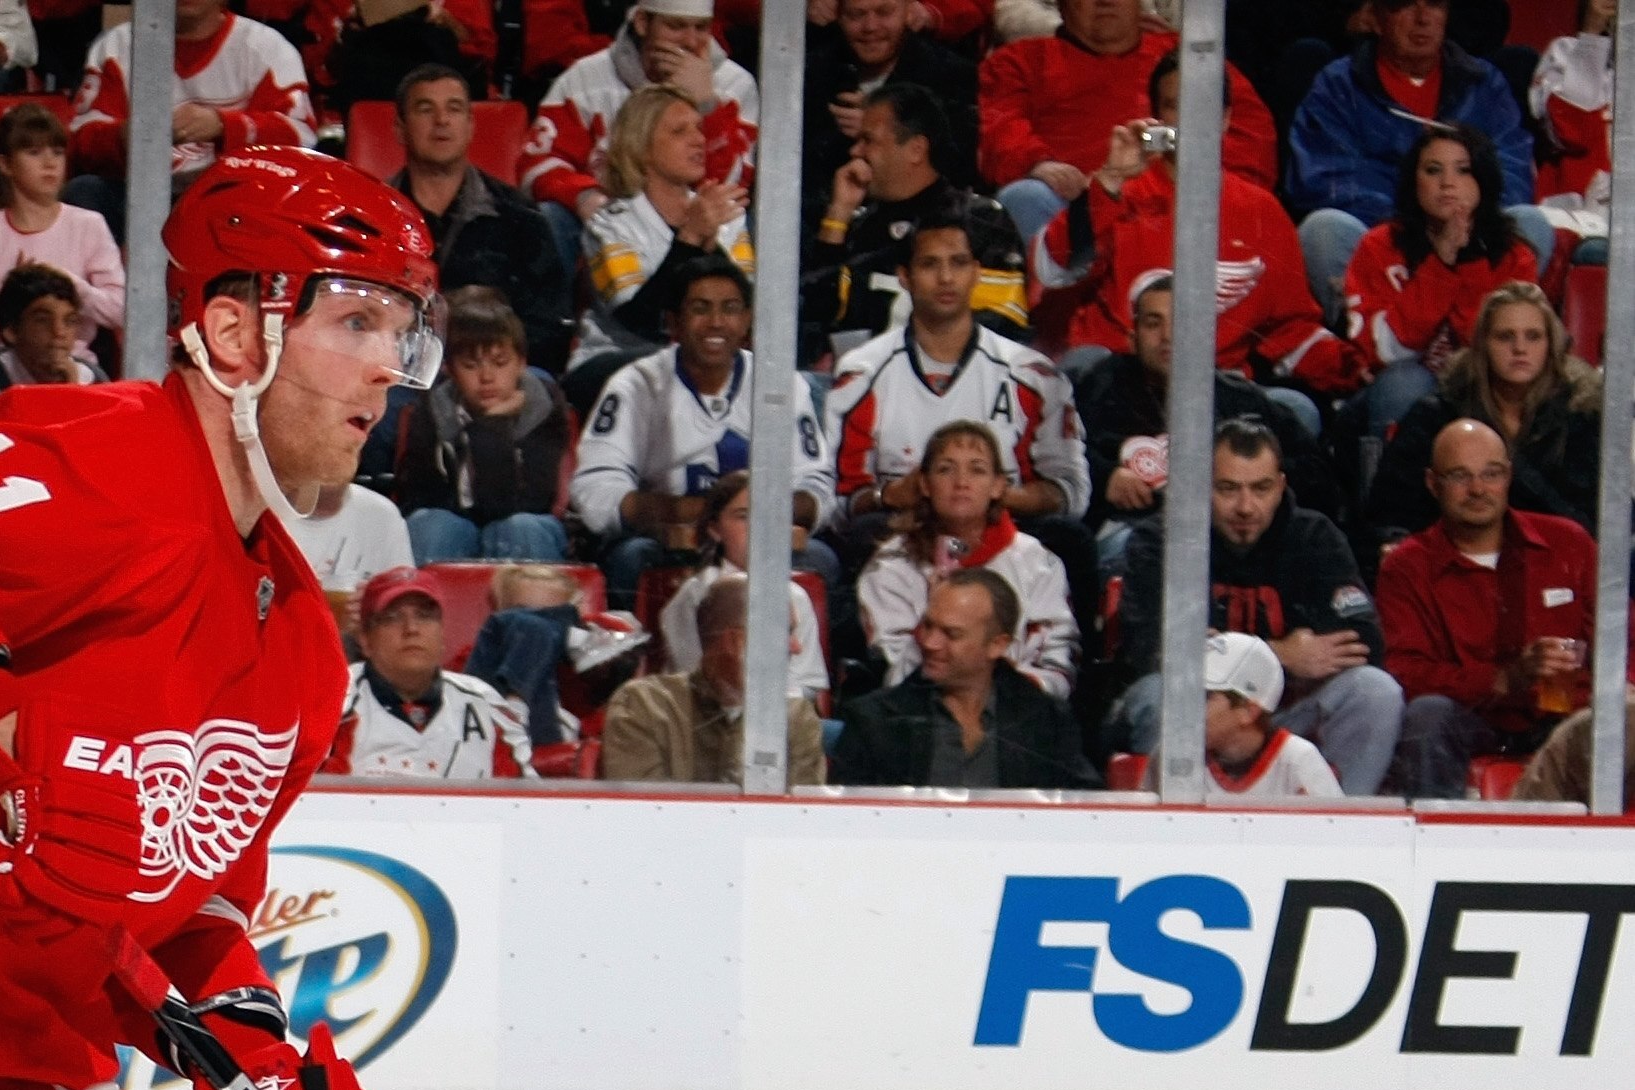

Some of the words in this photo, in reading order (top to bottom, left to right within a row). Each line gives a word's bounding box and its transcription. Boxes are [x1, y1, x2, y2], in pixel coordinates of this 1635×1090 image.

[990, 381, 1013, 424] A
[463, 702, 486, 742] A
[62, 735, 144, 780] EA
